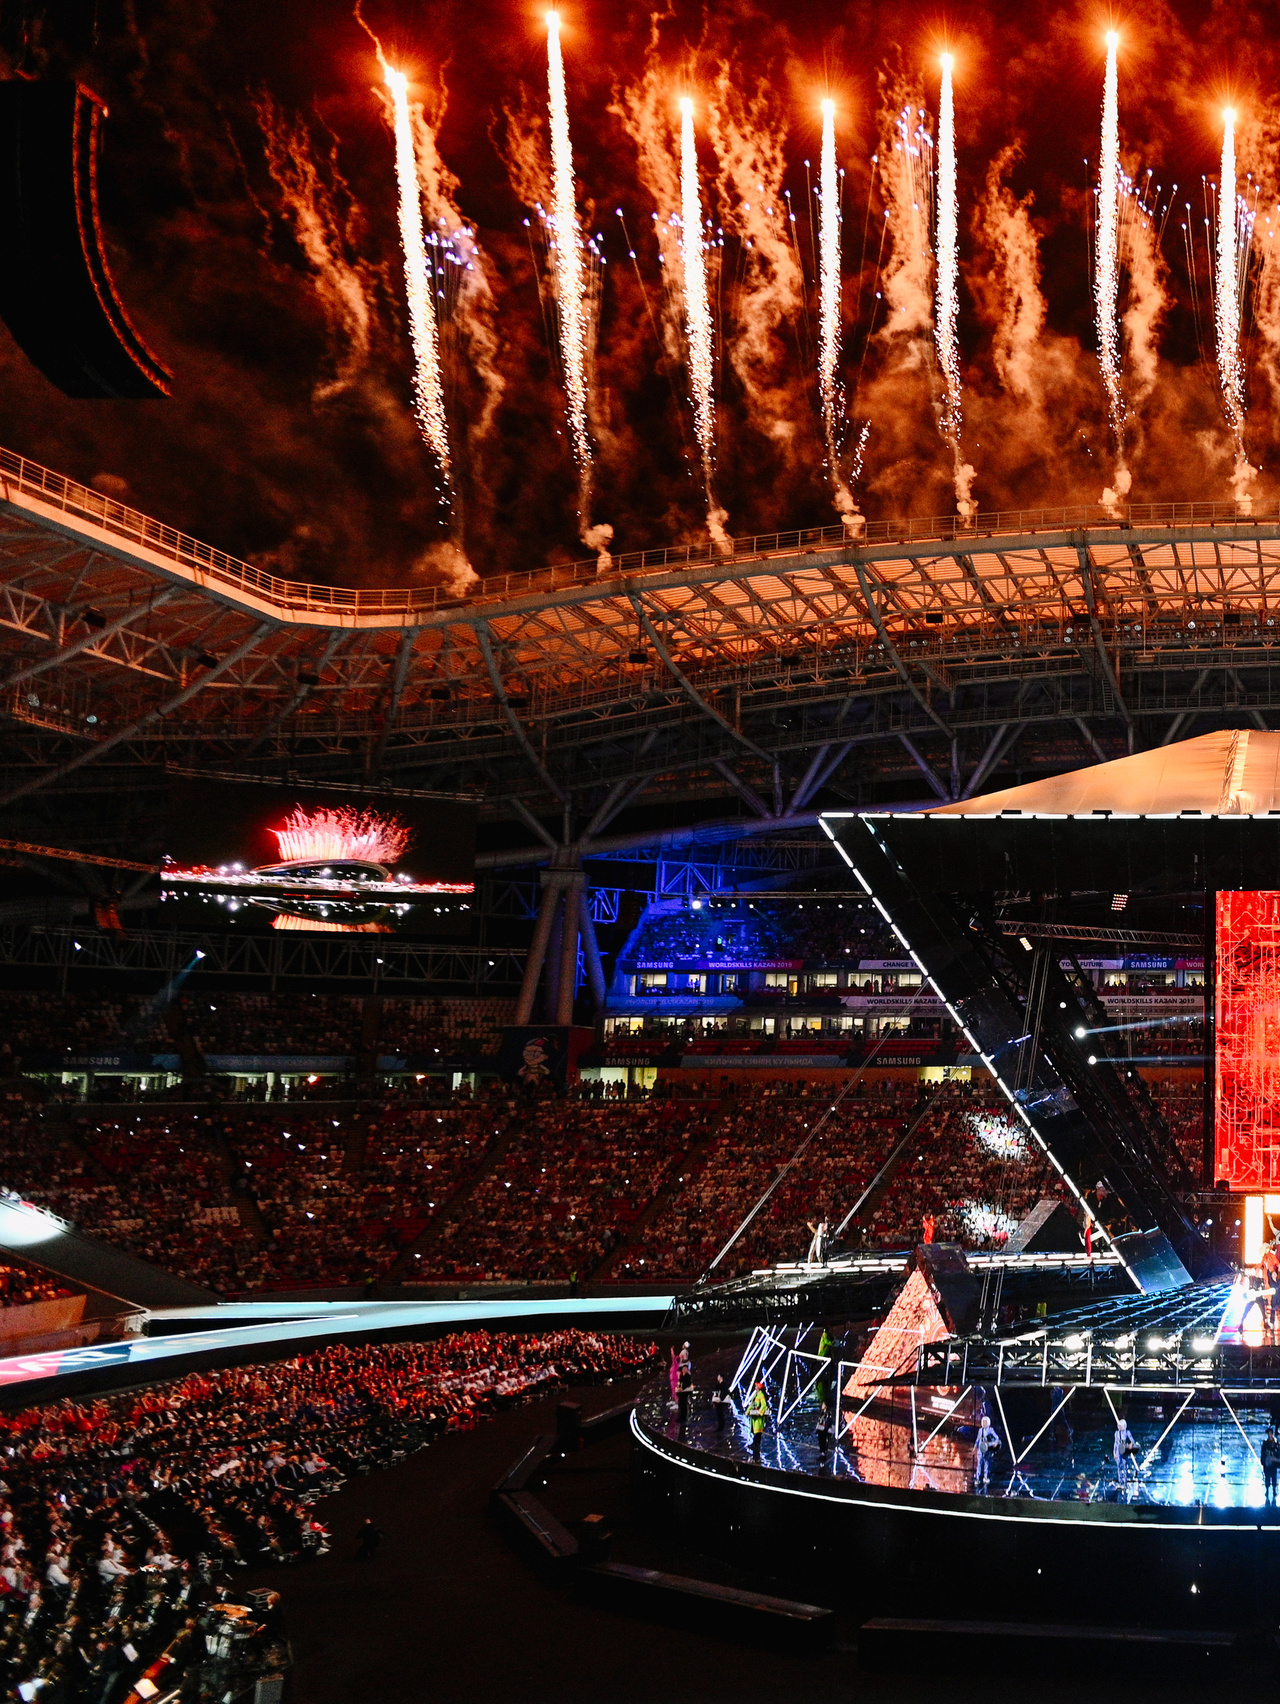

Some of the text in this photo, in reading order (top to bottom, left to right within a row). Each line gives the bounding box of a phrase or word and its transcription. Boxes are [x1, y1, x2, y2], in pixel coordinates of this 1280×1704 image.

[62, 1056, 121, 1065] SAMSUNG
[605, 1058, 651, 1066] SAMSUNG
[876, 1057, 921, 1065] SAMSUNG
